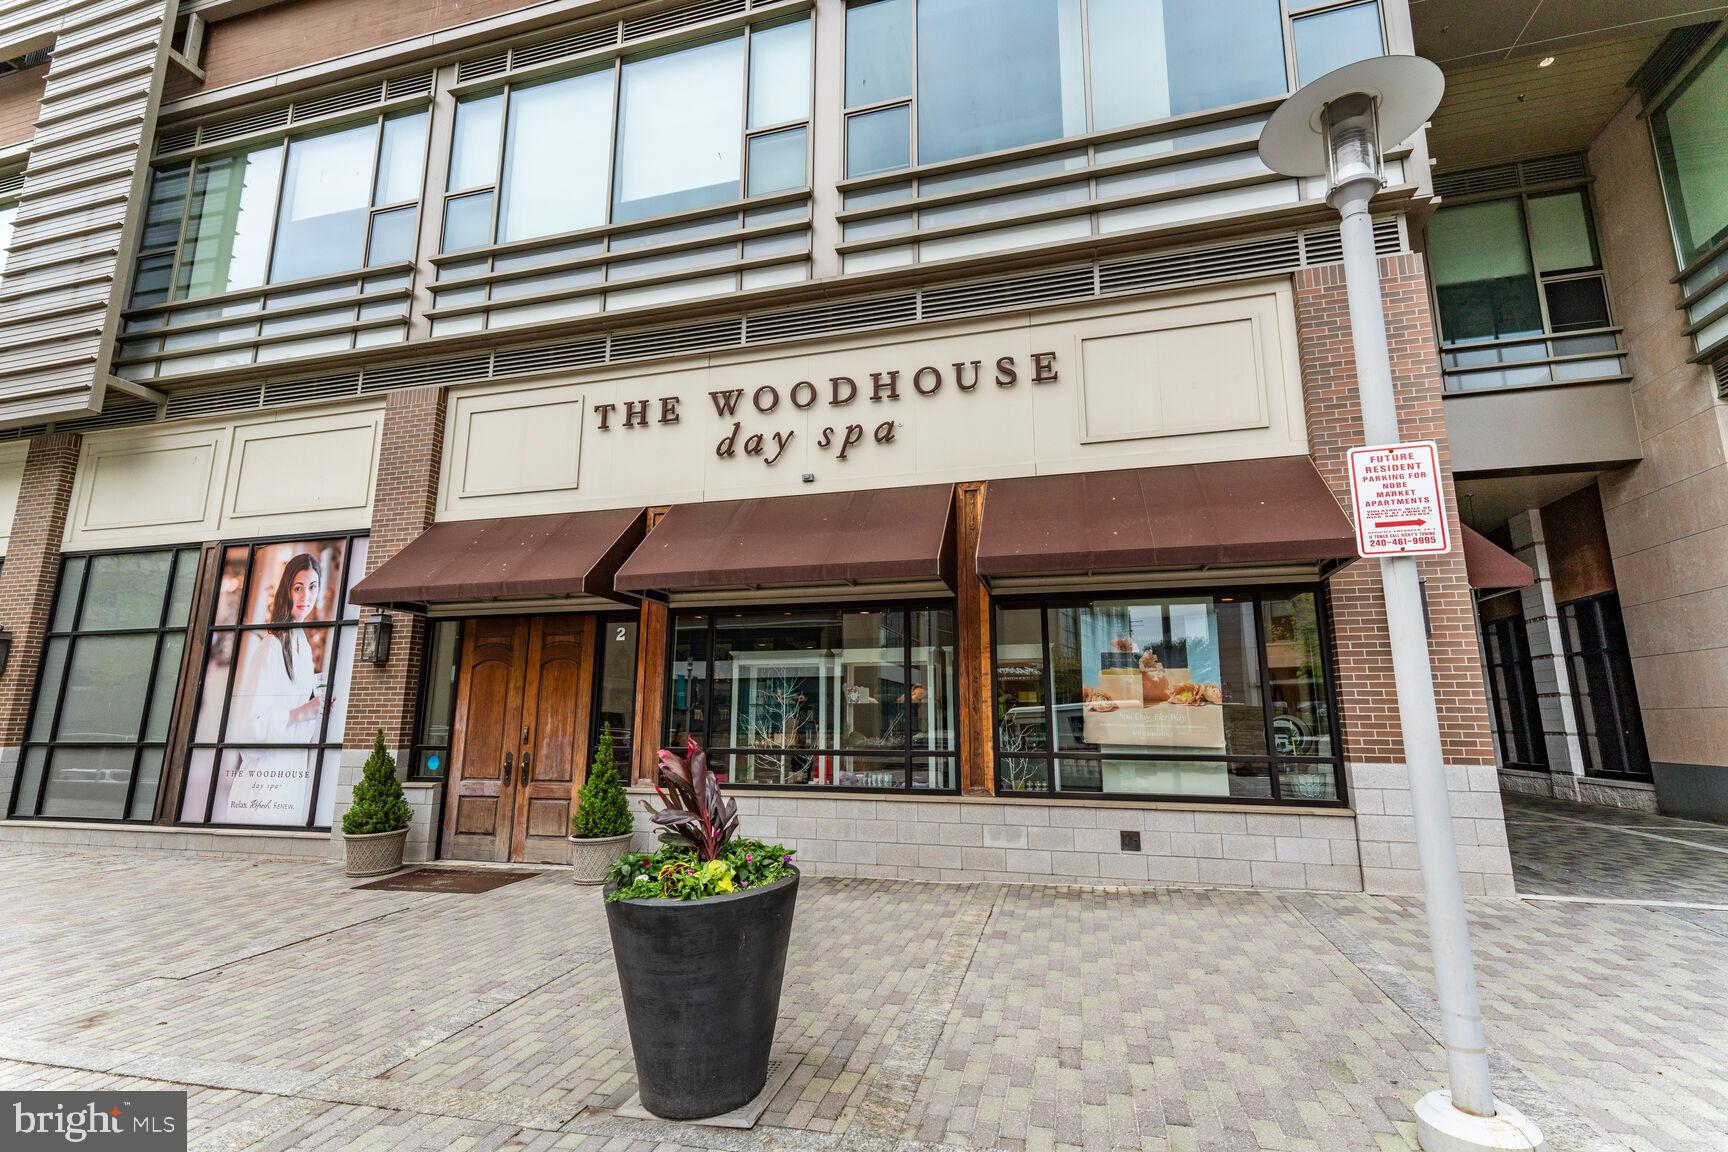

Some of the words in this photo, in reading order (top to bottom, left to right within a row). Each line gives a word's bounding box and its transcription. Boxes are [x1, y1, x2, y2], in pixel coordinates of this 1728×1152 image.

[594, 395, 681, 430] THE
[707, 351, 1059, 417] WOODHOUSE
[715, 421, 796, 466] day
[816, 419, 897, 460] spa
[1369, 452, 1415, 464] FUTURE
[1365, 462, 1422, 474] RESIDENT
[1362, 473, 1405, 483] PARKING
[1408, 471, 1427, 479] FOR
[1382, 481, 1408, 489] NOBE
[1376, 488, 1416, 498] MARKET
[1365, 496, 1430, 508] APARTMENTS
[1369, 536, 1437, 547] 240-461-9995
[616, 627, 626, 641] 2
[225, 770, 244, 778] THE
[248, 770, 311, 779] WOODHOUSE
[251, 782, 264, 791] day
[266, 783, 280, 791] spa
